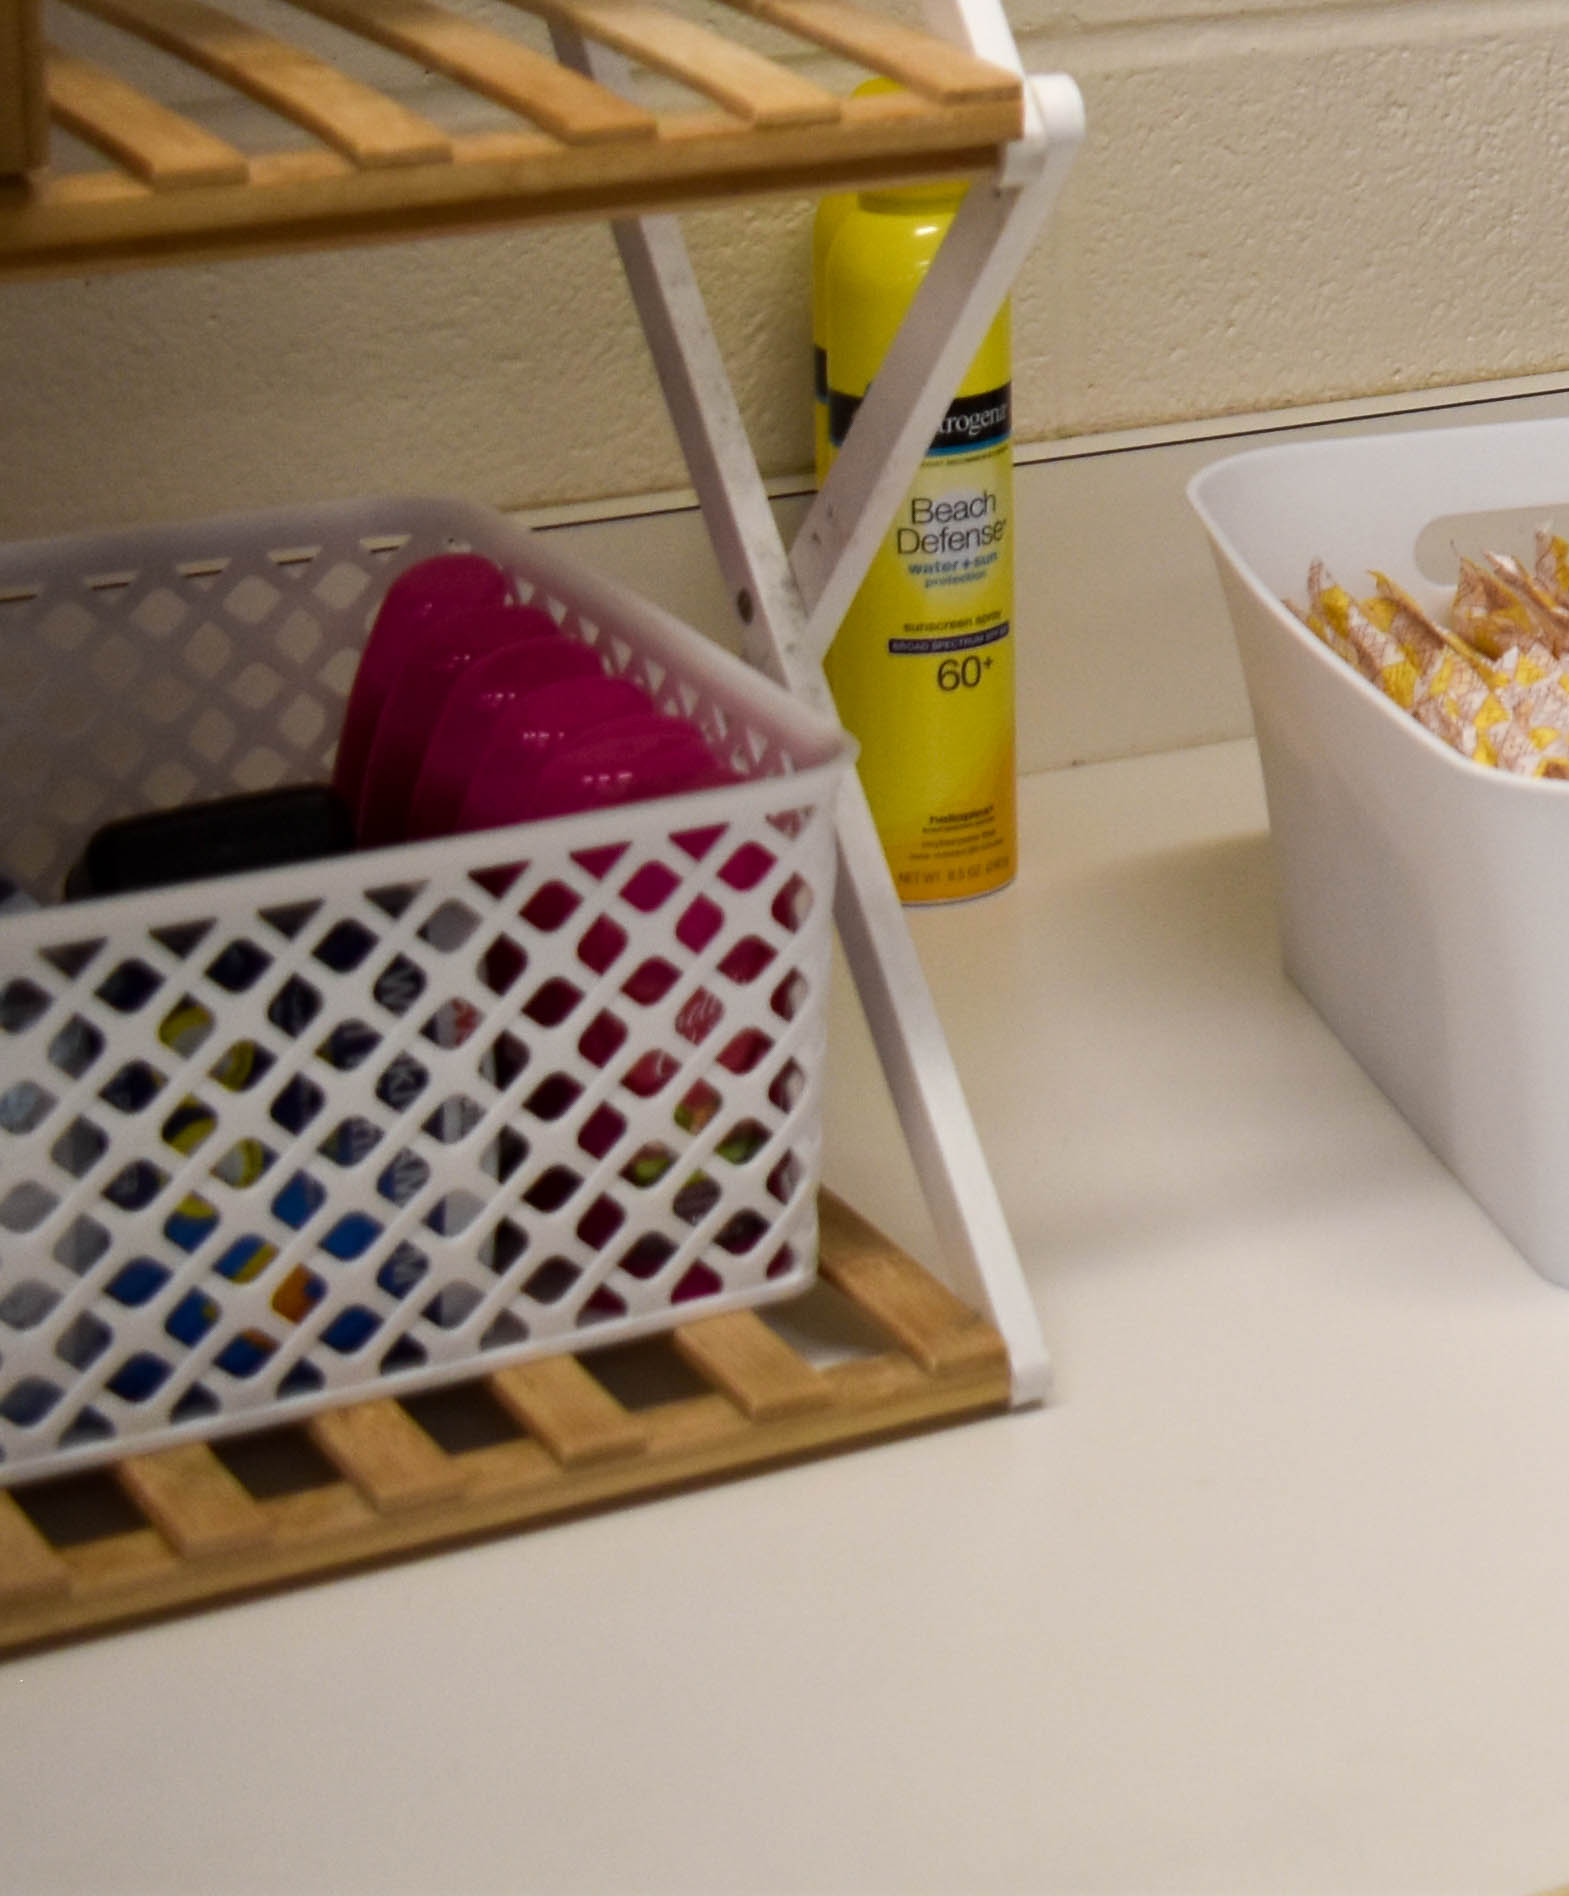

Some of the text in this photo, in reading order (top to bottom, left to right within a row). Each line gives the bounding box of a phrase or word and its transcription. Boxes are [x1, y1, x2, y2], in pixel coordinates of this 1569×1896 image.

[911, 489, 997, 524] Beach
[897, 522, 1003, 554] Defense
[907, 557, 959, 574] water
[924, 569, 987, 588] protection
[904, 618, 973, 633] sunscreen
